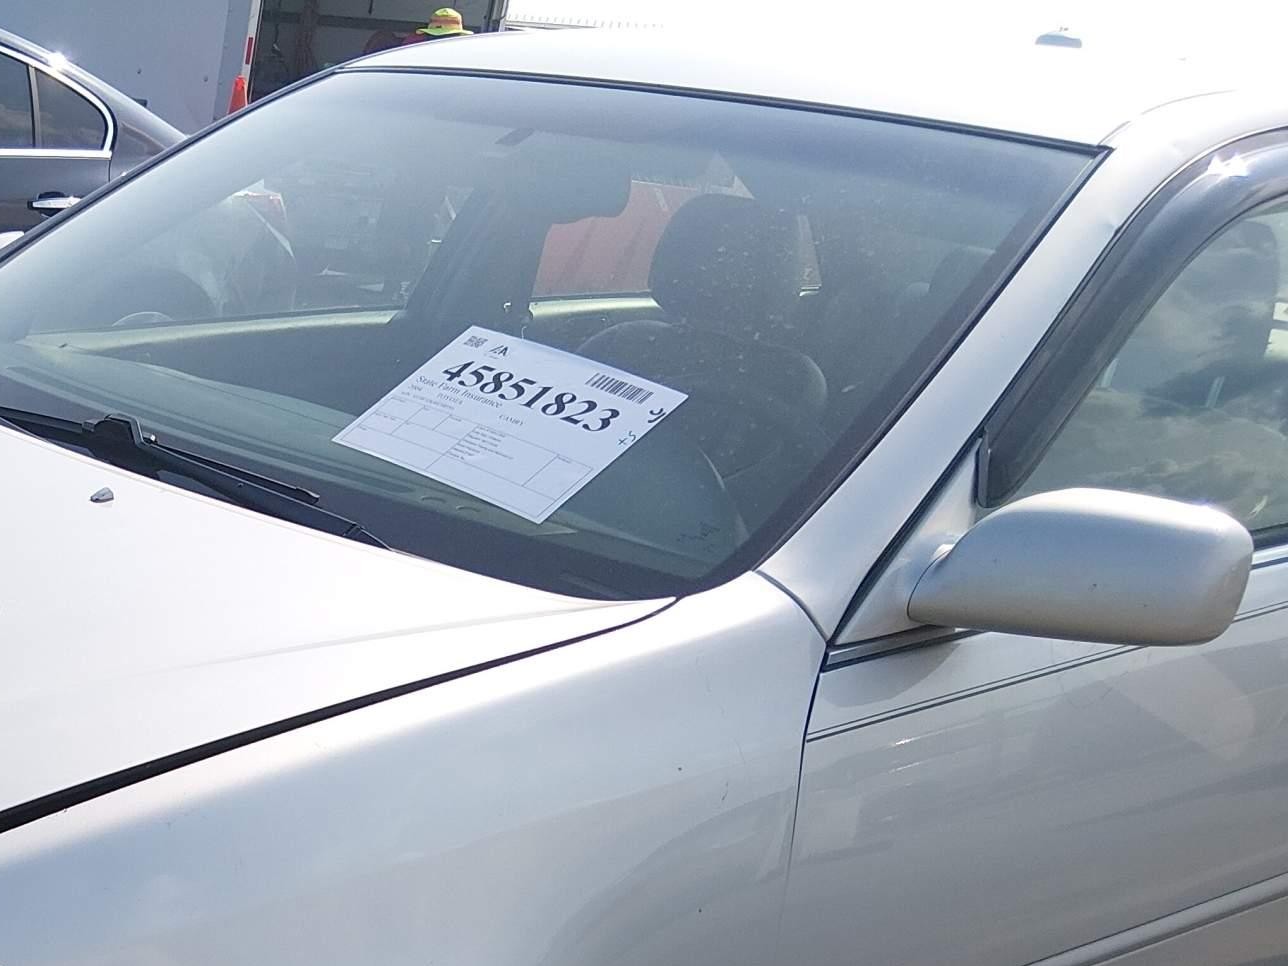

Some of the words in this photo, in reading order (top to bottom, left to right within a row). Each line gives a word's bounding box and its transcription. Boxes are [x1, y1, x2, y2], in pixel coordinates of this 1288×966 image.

[417, 375, 436, 388] State
[438, 381, 459, 396] Farm
[461, 389, 504, 410] Insurance
[441, 361, 620, 431] 45851823
